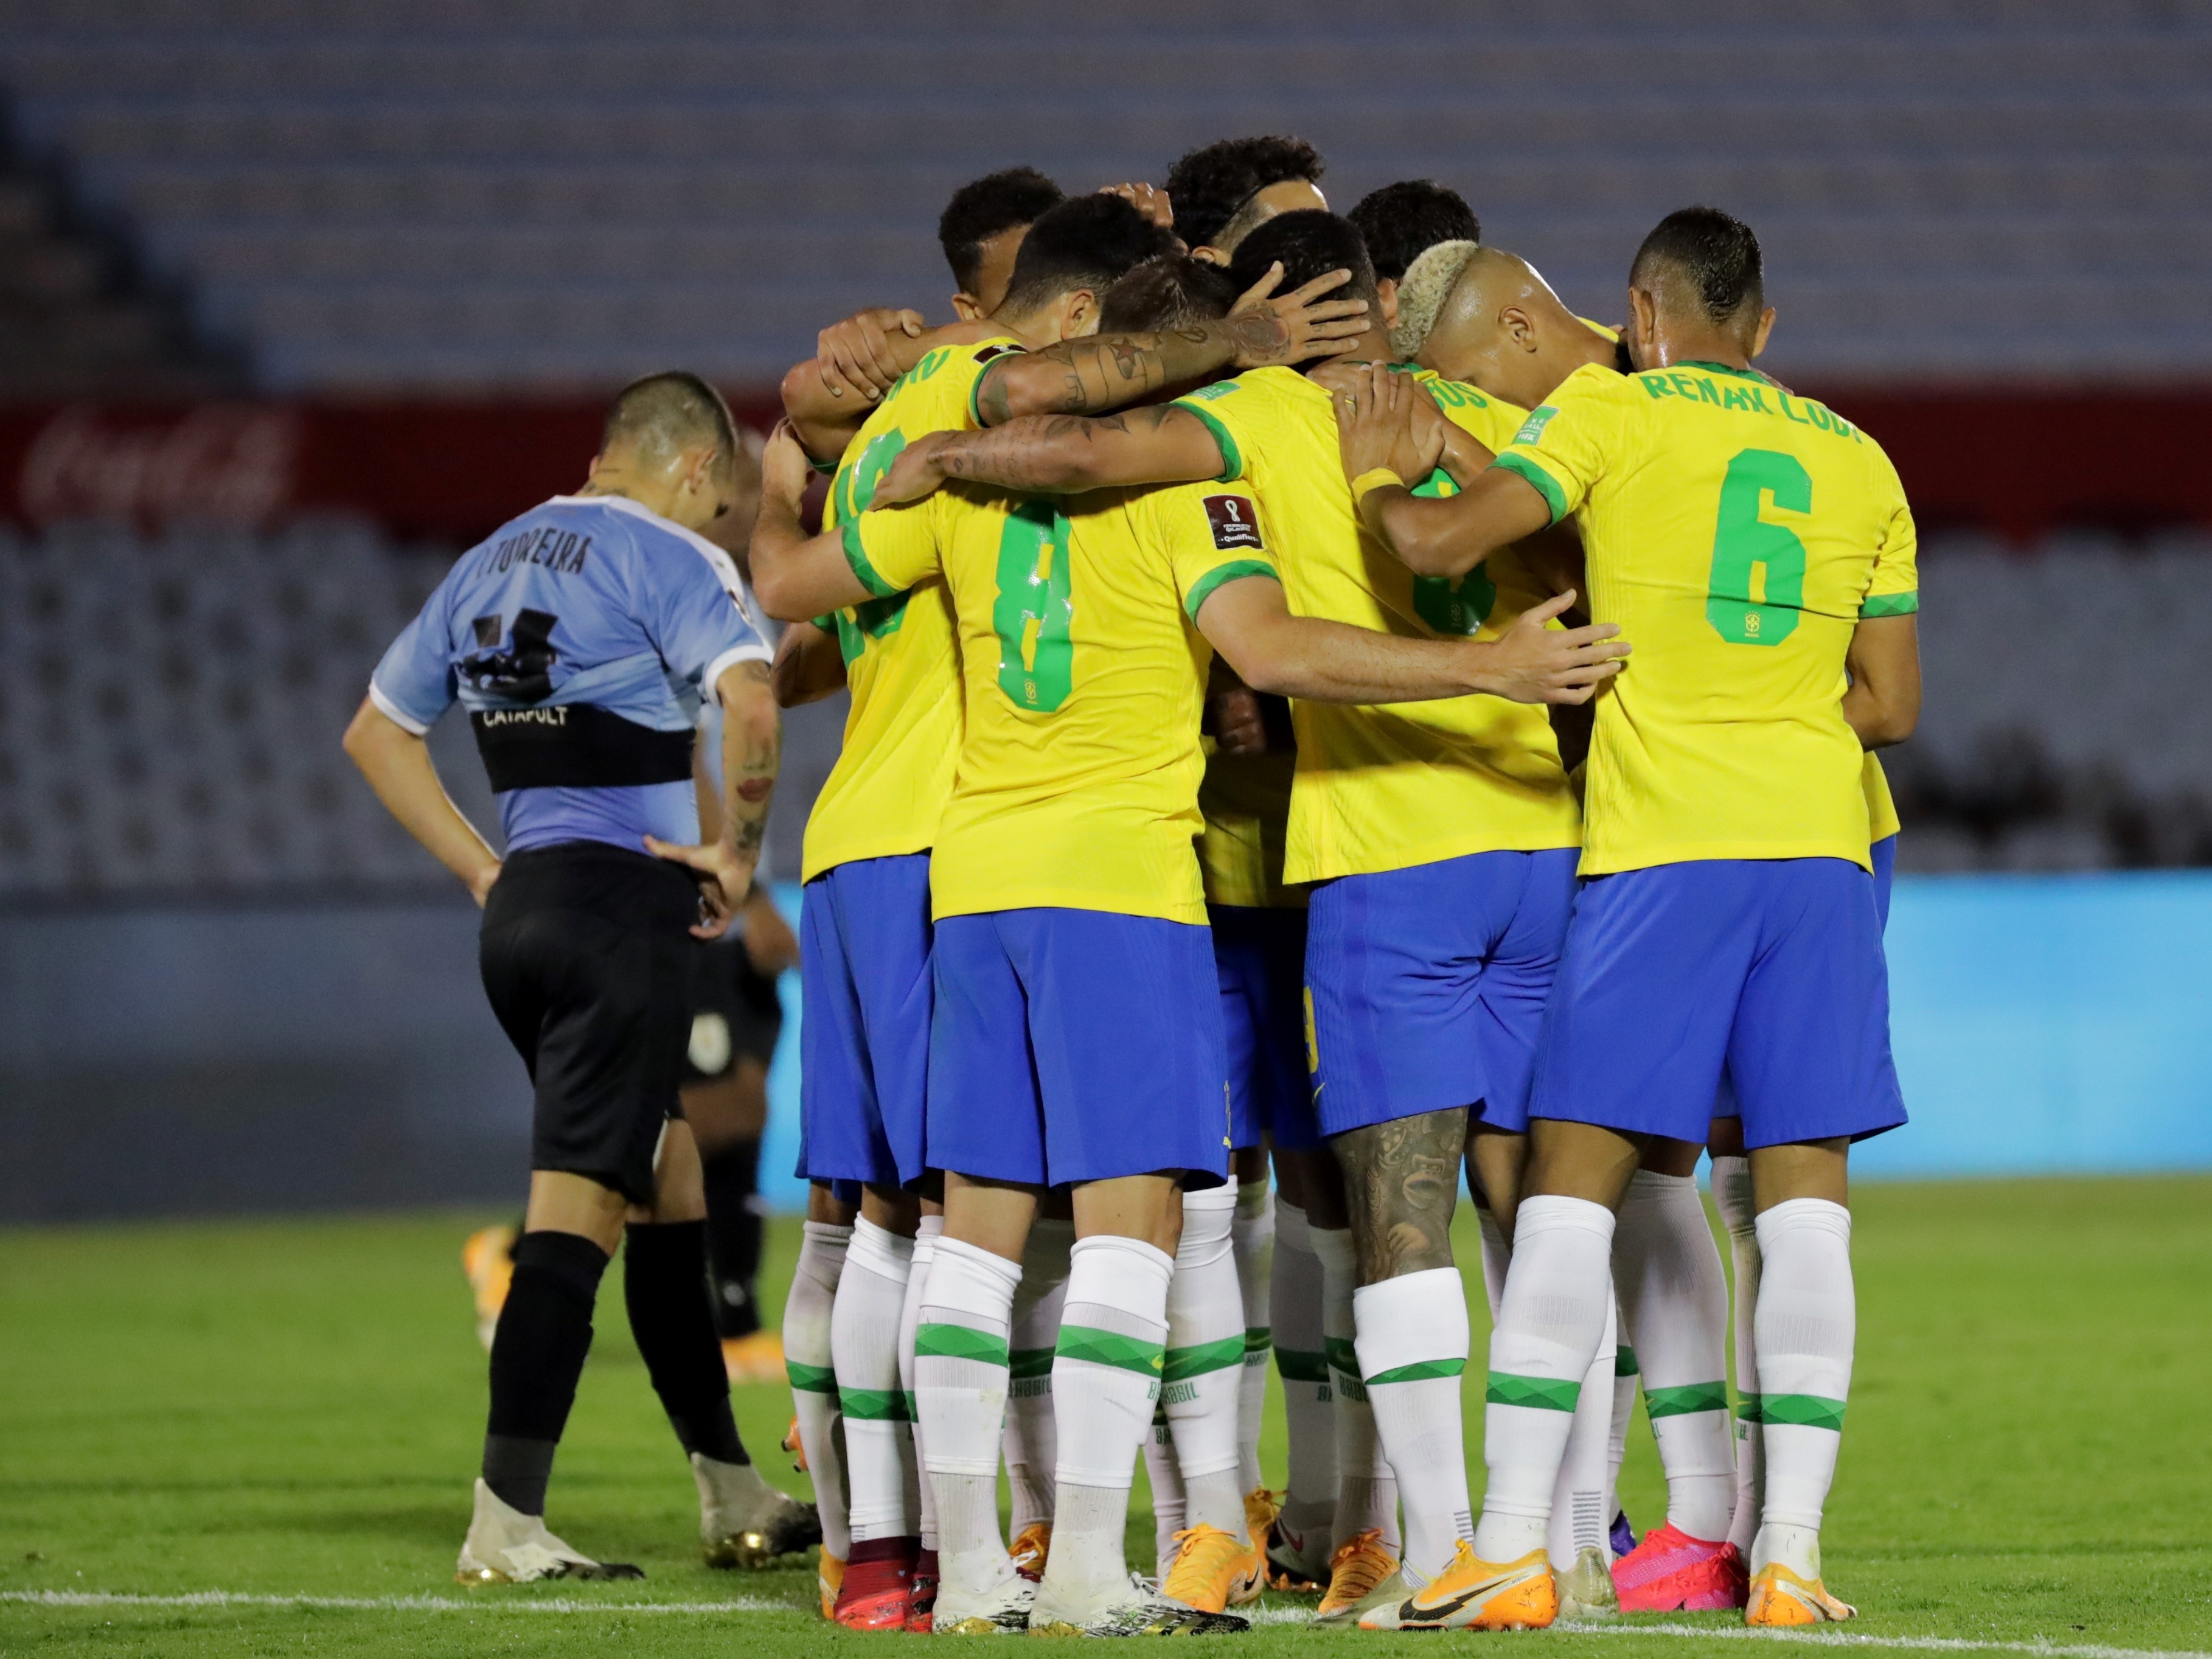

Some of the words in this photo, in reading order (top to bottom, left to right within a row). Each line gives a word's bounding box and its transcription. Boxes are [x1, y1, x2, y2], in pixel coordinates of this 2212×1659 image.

[1639, 373, 1774, 416] RENAN
[1224, 534, 1256, 543] Qualifiers
[1705, 447, 1812, 646] 6
[993, 499, 1074, 712] 8
